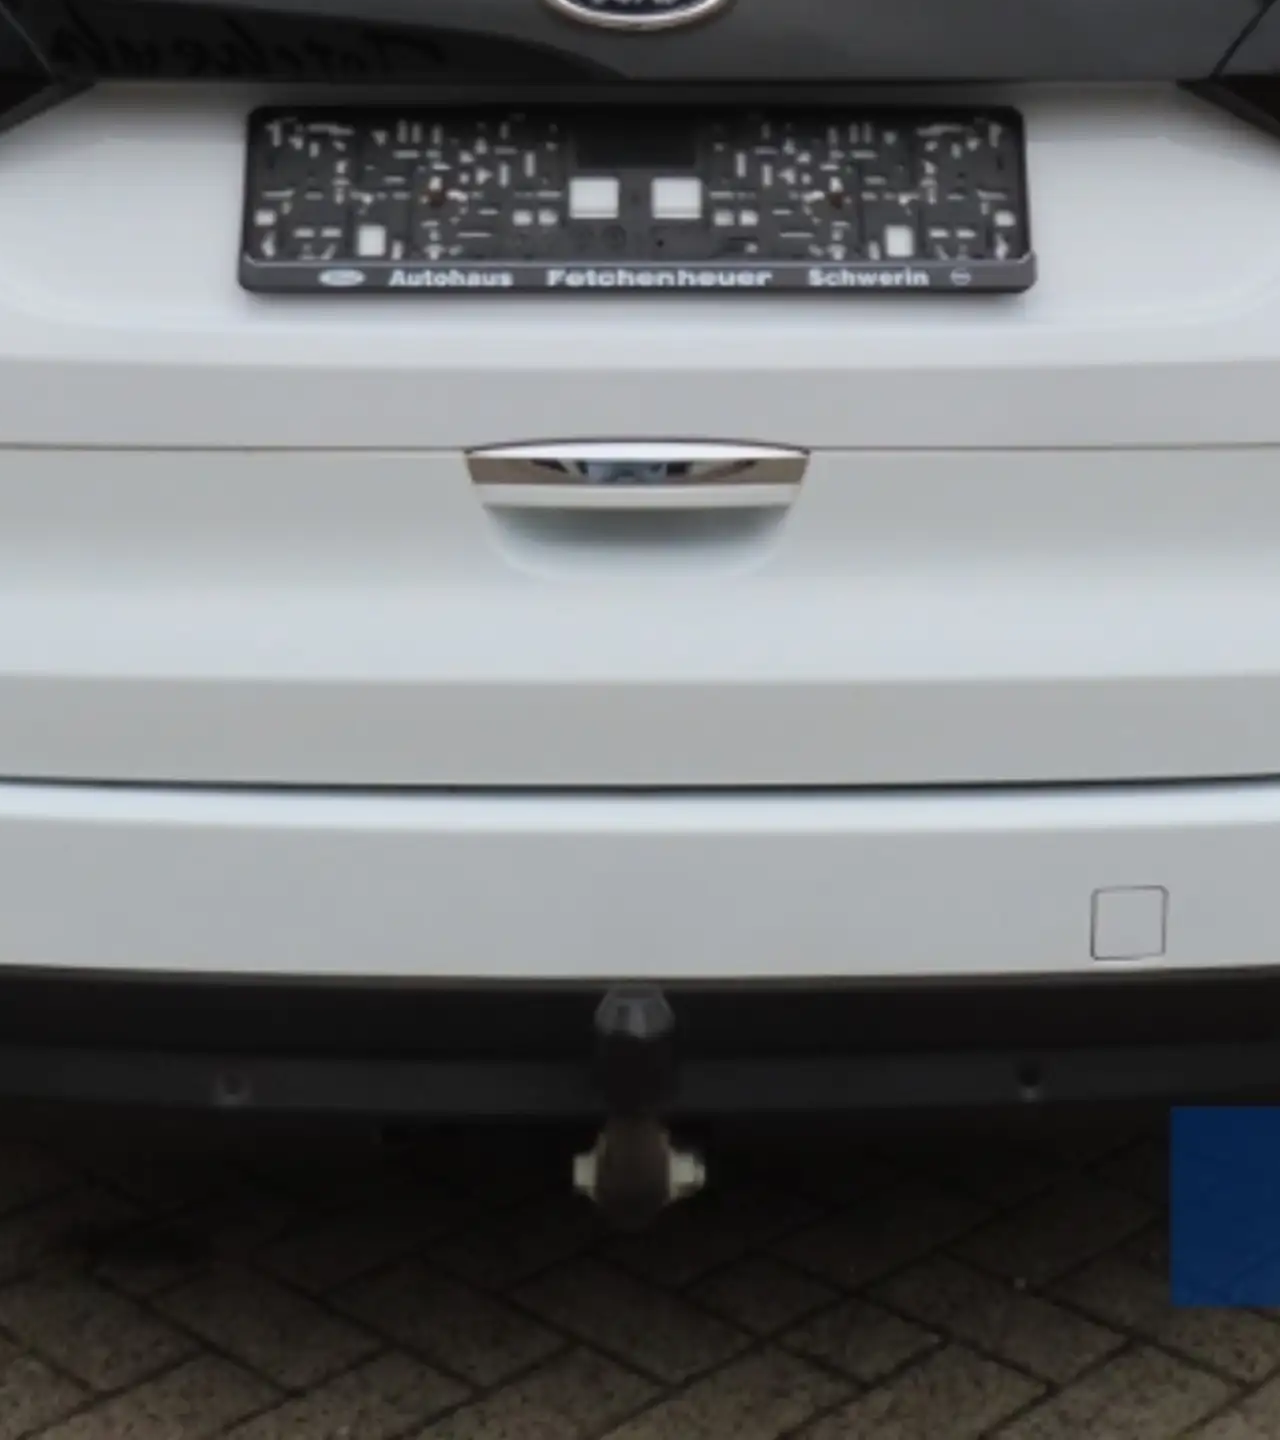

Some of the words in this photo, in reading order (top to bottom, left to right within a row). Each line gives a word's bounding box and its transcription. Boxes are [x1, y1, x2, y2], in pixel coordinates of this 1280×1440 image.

[388, 268, 514, 288] Autohaus
[545, 267, 774, 288] Fetchenheuer
[807, 267, 931, 288] Schwerin
